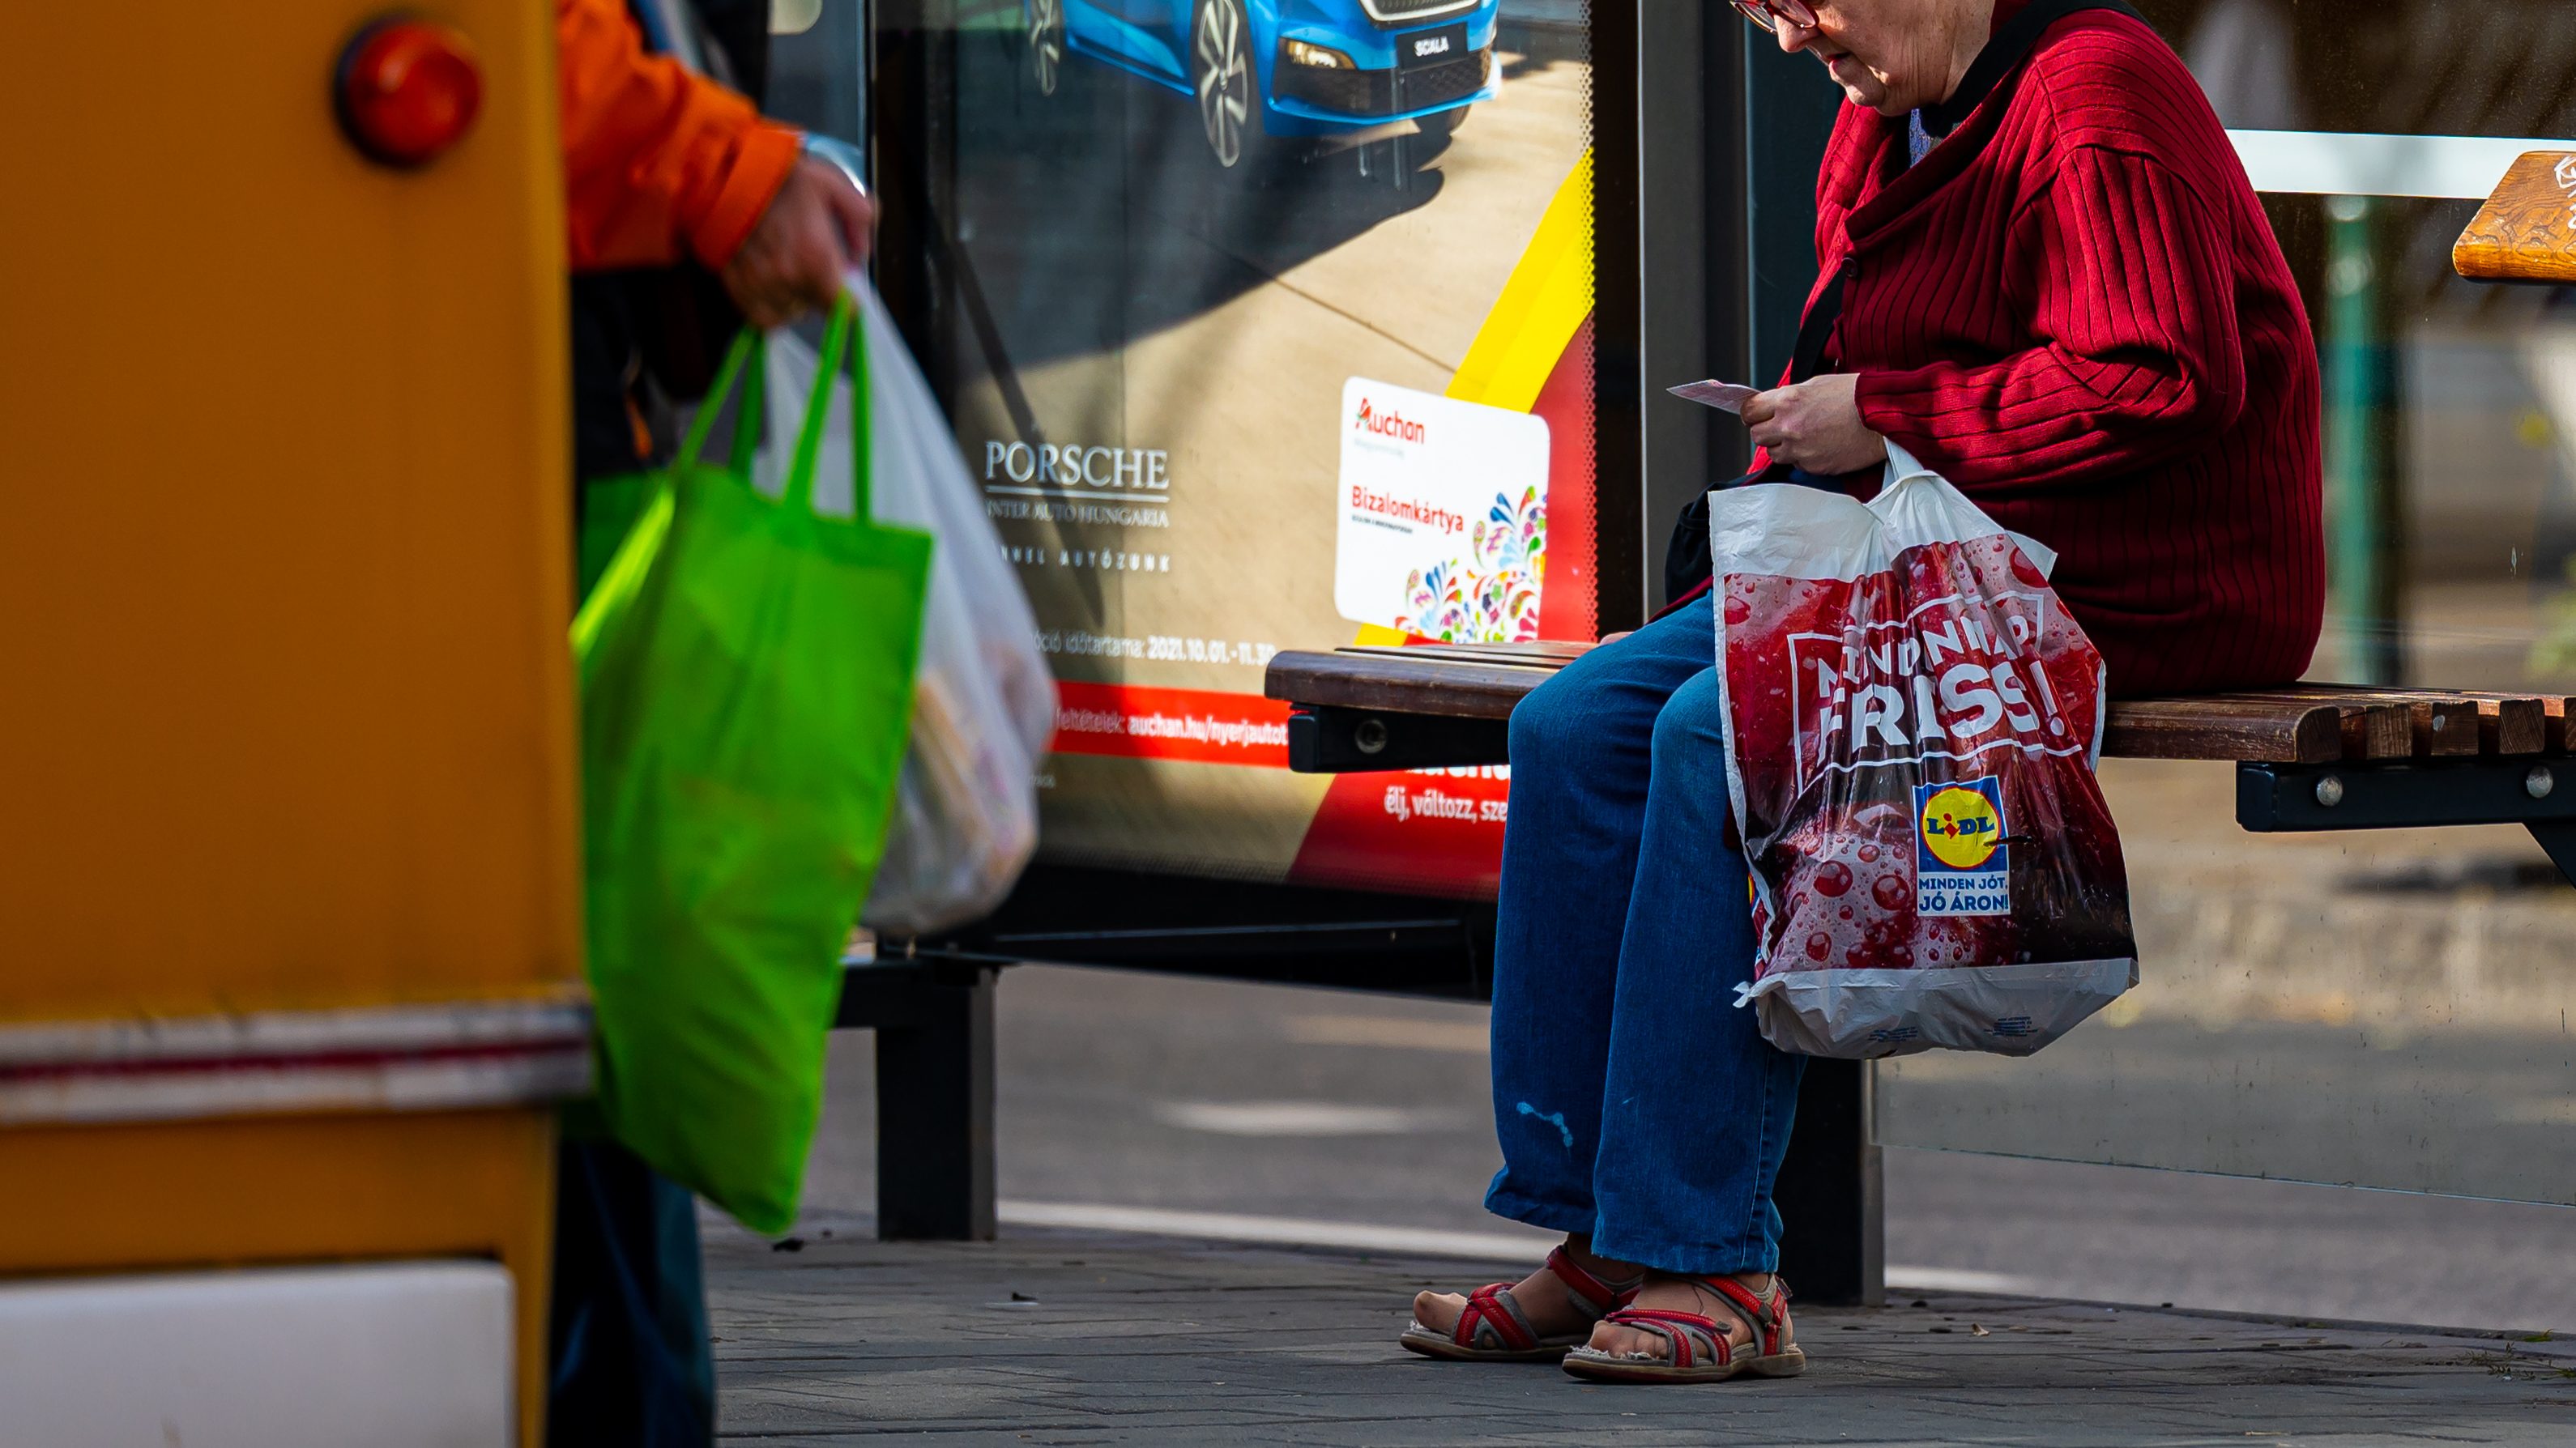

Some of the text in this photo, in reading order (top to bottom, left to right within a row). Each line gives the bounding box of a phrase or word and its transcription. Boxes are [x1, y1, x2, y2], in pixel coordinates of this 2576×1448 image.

[1414, 36, 1449, 57] SCALA
[1355, 397, 1425, 444] Auchan
[985, 441, 1169, 489] PORSCHE
[1351, 485, 1464, 534] Bizalomkártya
[1918, 878, 1975, 890] MINDEN
[1919, 891, 2009, 912] JÓ ÁRON!
